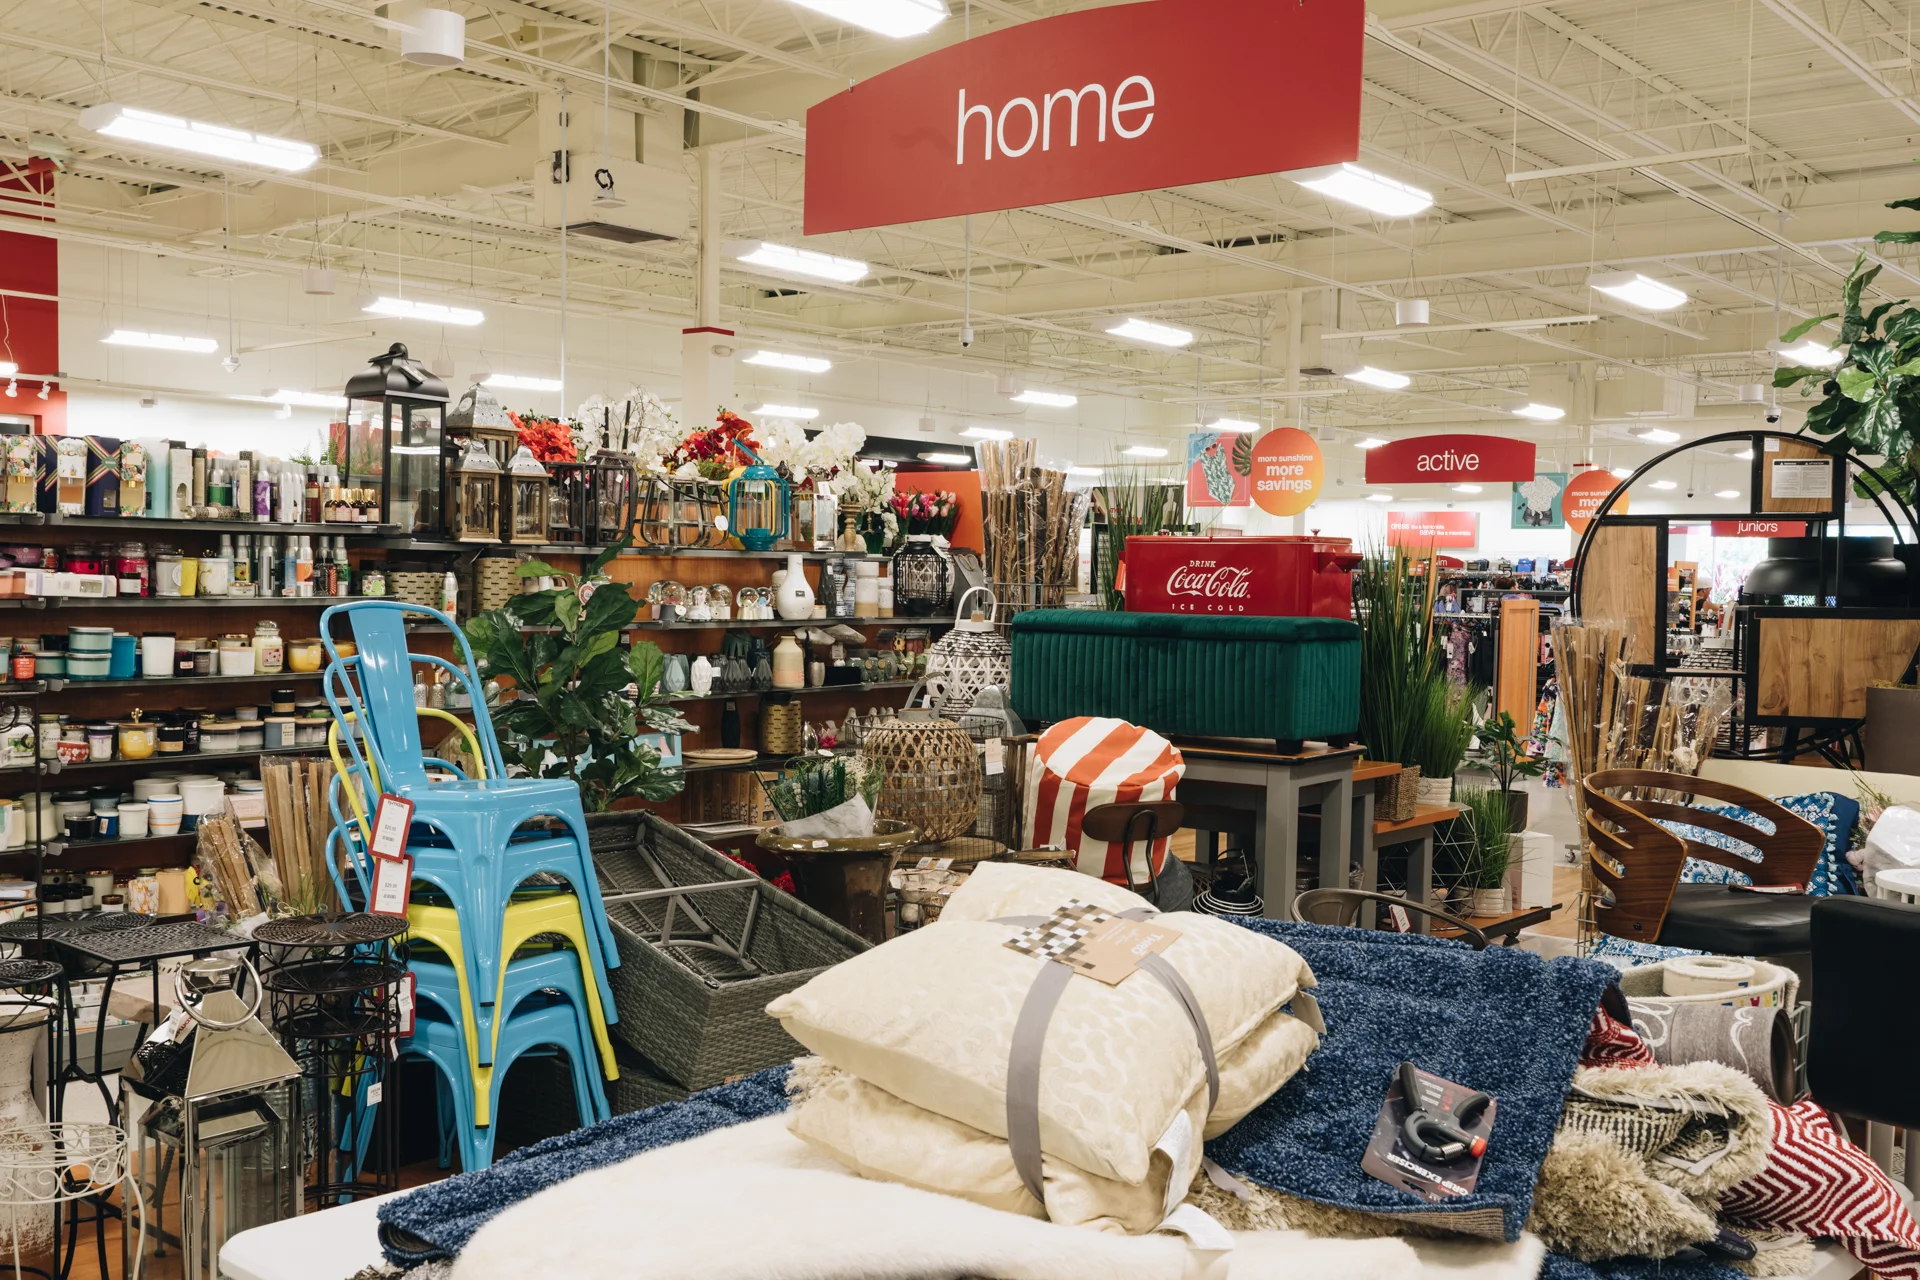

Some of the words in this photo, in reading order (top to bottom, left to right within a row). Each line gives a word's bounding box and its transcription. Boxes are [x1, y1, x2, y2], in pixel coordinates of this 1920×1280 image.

[956, 74, 1155, 165] home
[1257, 455, 1277, 463] more
[1278, 453, 1314, 462] sunshine
[1416, 448, 1480, 472] active
[1266, 464, 1304, 476] more
[1257, 476, 1313, 494] savings
[1578, 497, 1605, 507] mor
[1736, 520, 1779, 535] juniors
[1189, 560, 1217, 568] DRINK
[1166, 565, 1255, 598] Coca-Cola
[1171, 603, 1195, 611] ICE
[1207, 604, 1244, 612] COLD
[1386, 1152, 1443, 1184] EXERCISER
[1441, 1179, 1469, 1197] GRIP
